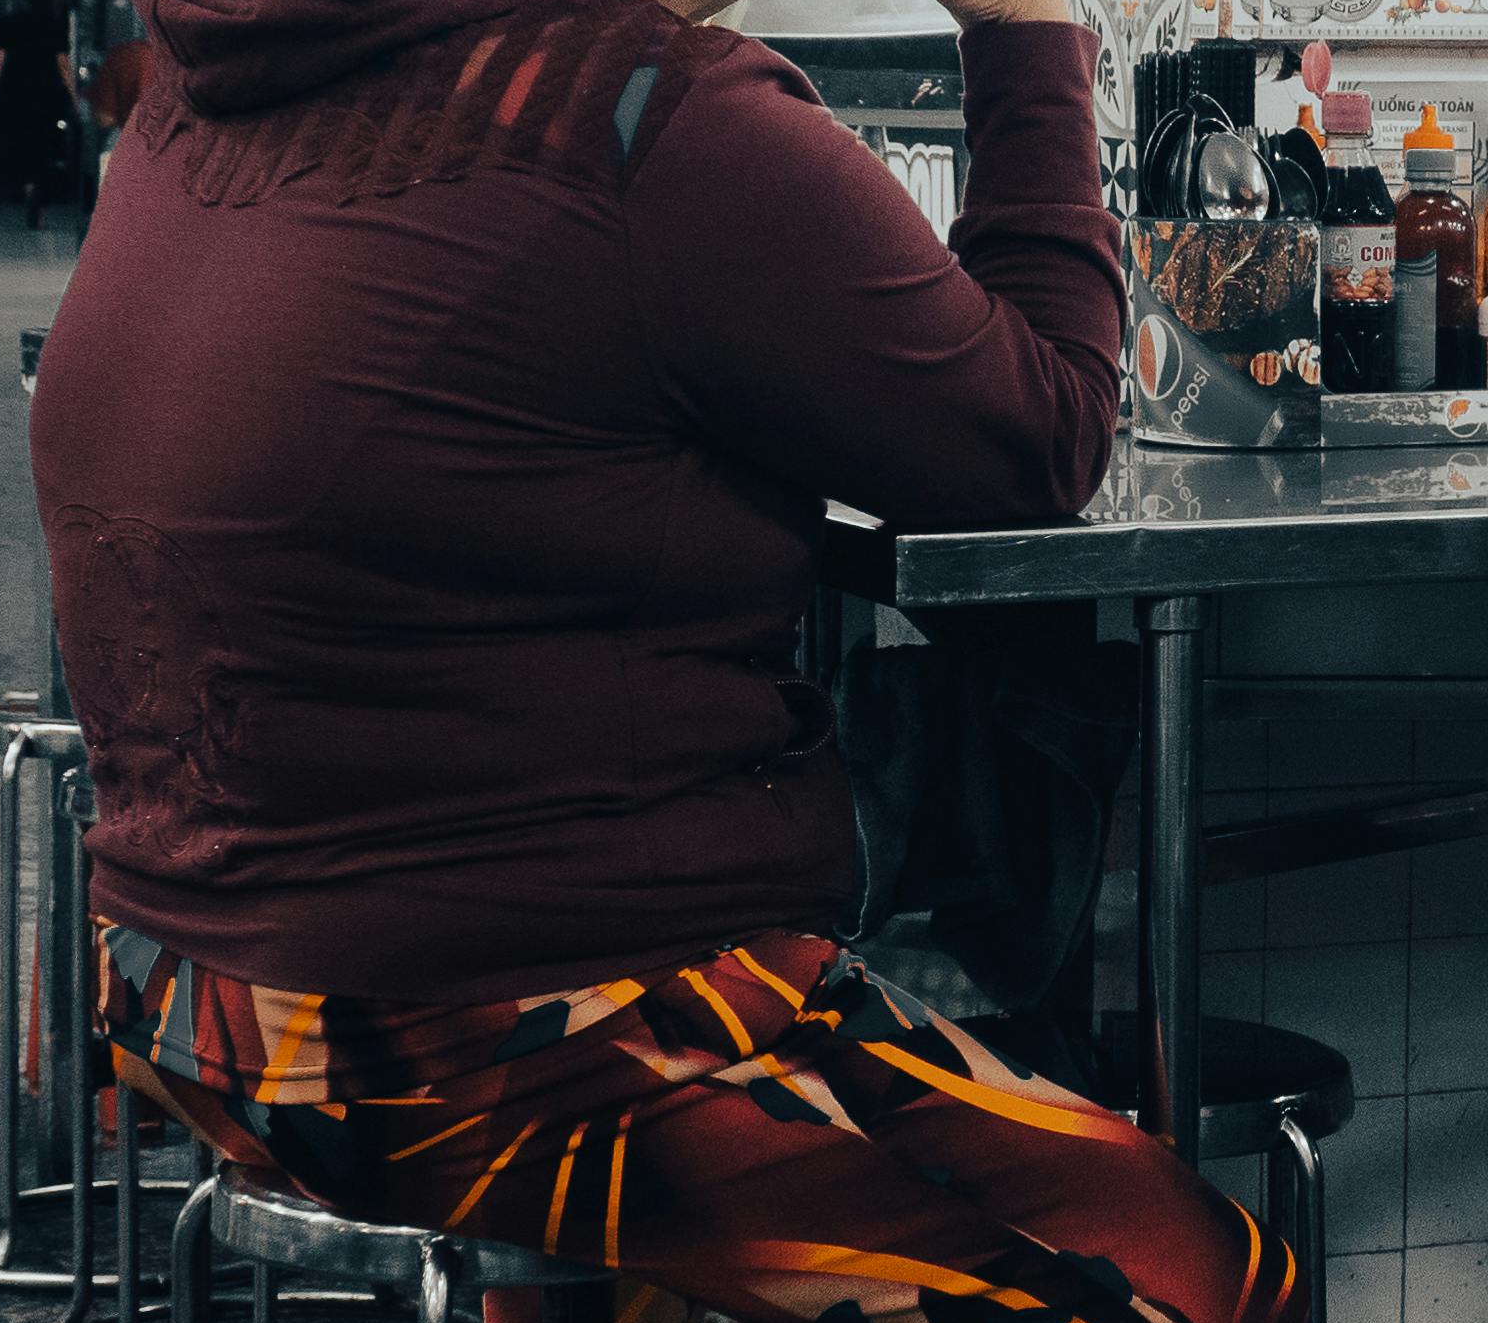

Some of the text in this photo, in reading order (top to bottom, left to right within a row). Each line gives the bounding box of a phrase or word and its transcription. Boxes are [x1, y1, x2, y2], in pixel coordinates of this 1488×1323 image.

[1379, 94, 1416, 112] UỐNG
[1440, 97, 1475, 112] TOÀN
[1170, 363, 1211, 430] pepsi
